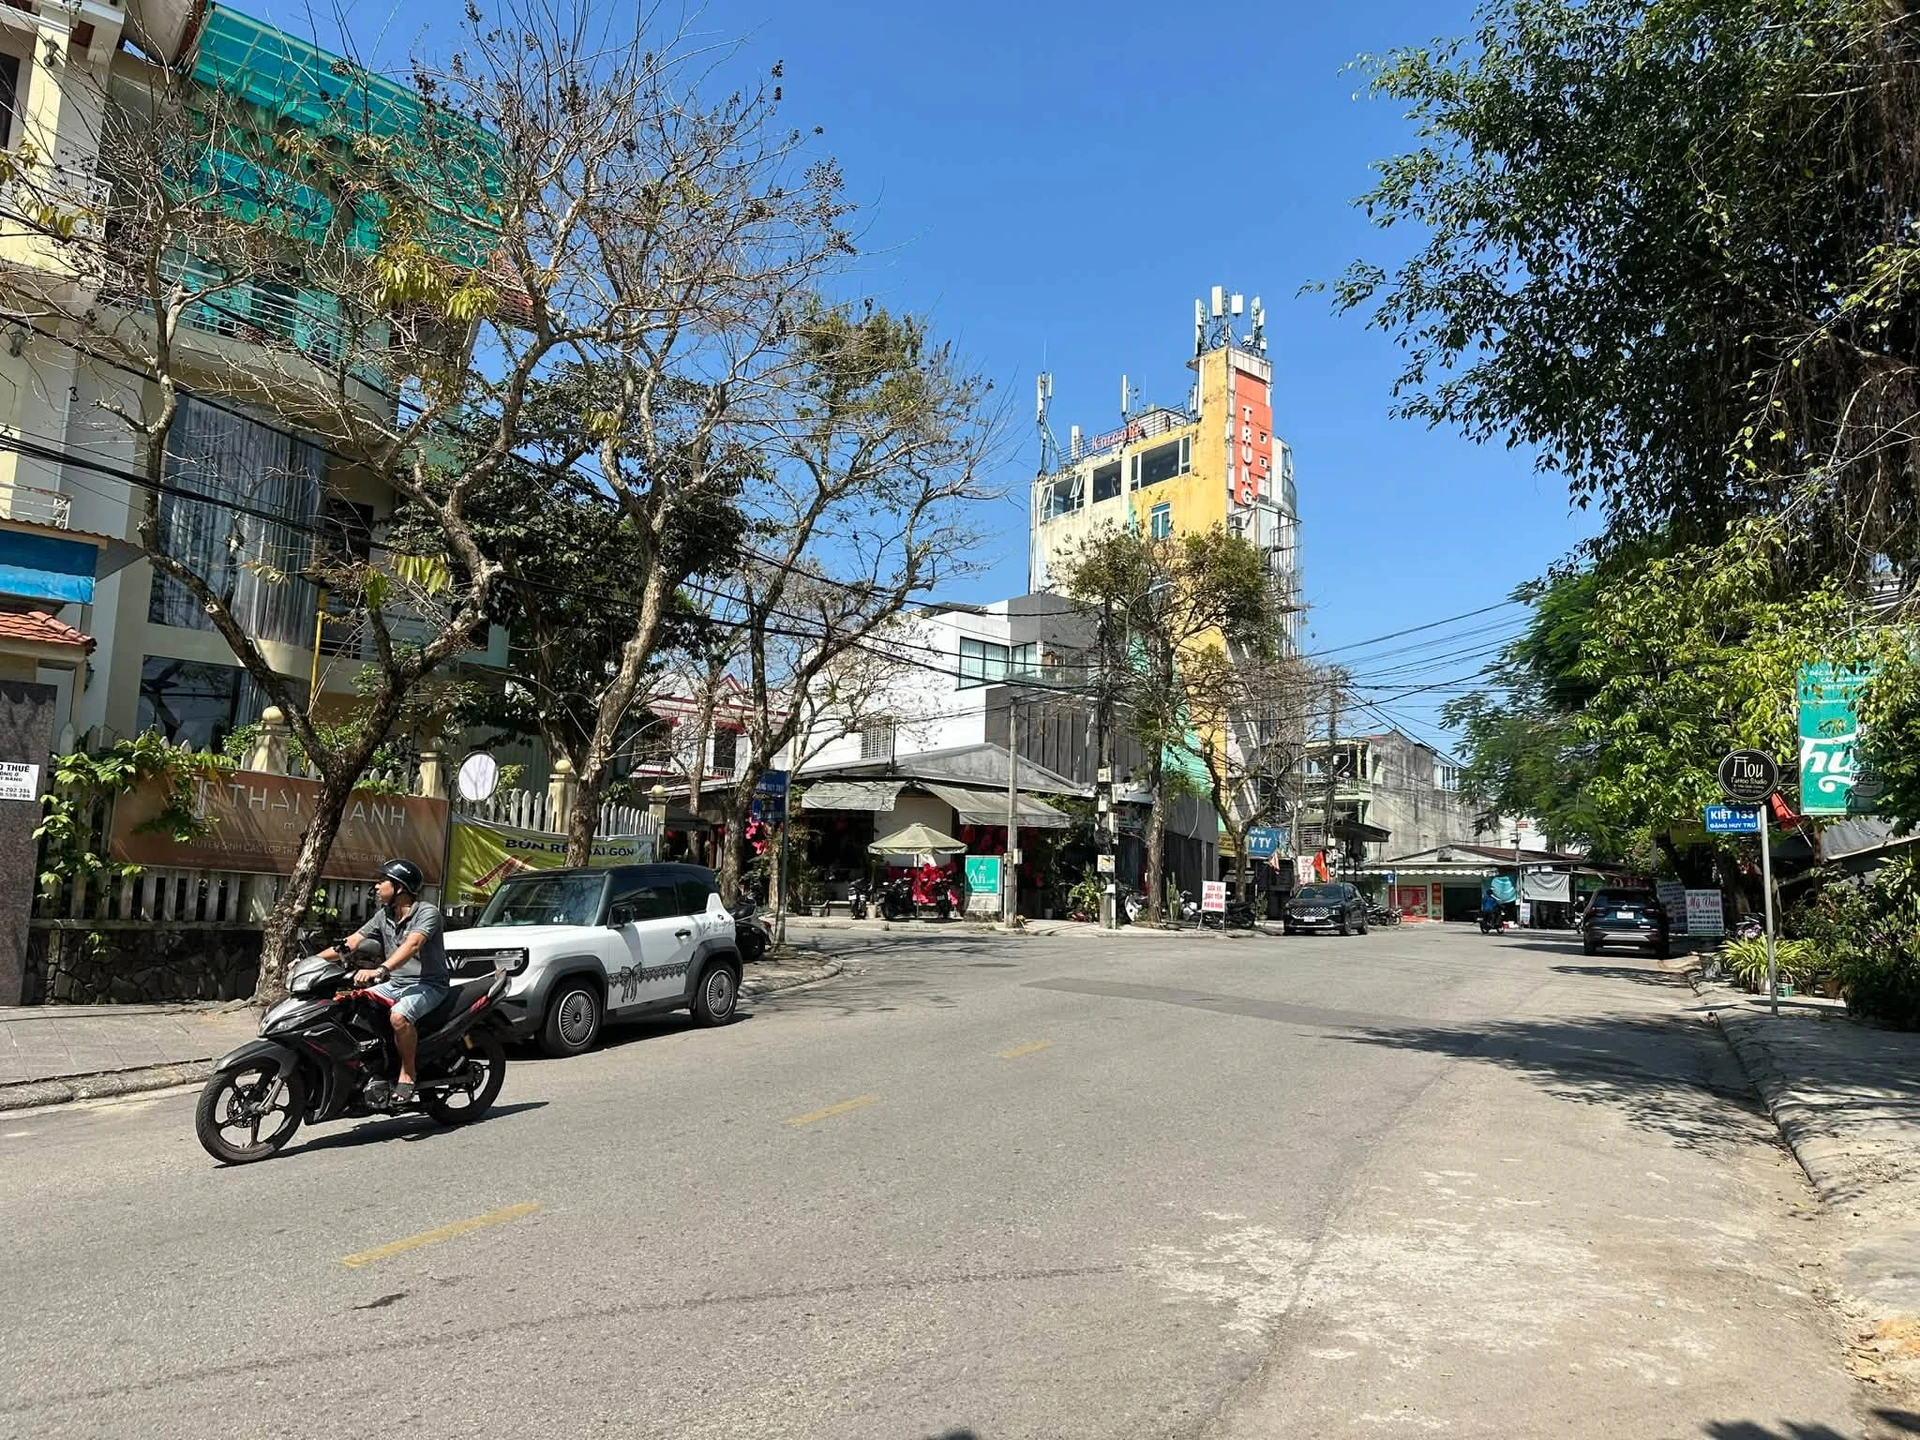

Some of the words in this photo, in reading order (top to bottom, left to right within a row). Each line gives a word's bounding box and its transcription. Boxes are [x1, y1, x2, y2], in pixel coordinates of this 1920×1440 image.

[1241, 405, 1253, 506] TRUNG
[6, 764, 30, 773] THUÊ
[1710, 808, 1732, 822] KIỆT
[1735, 810, 1755, 820] 133
[505, 838, 546, 850] BÚN
